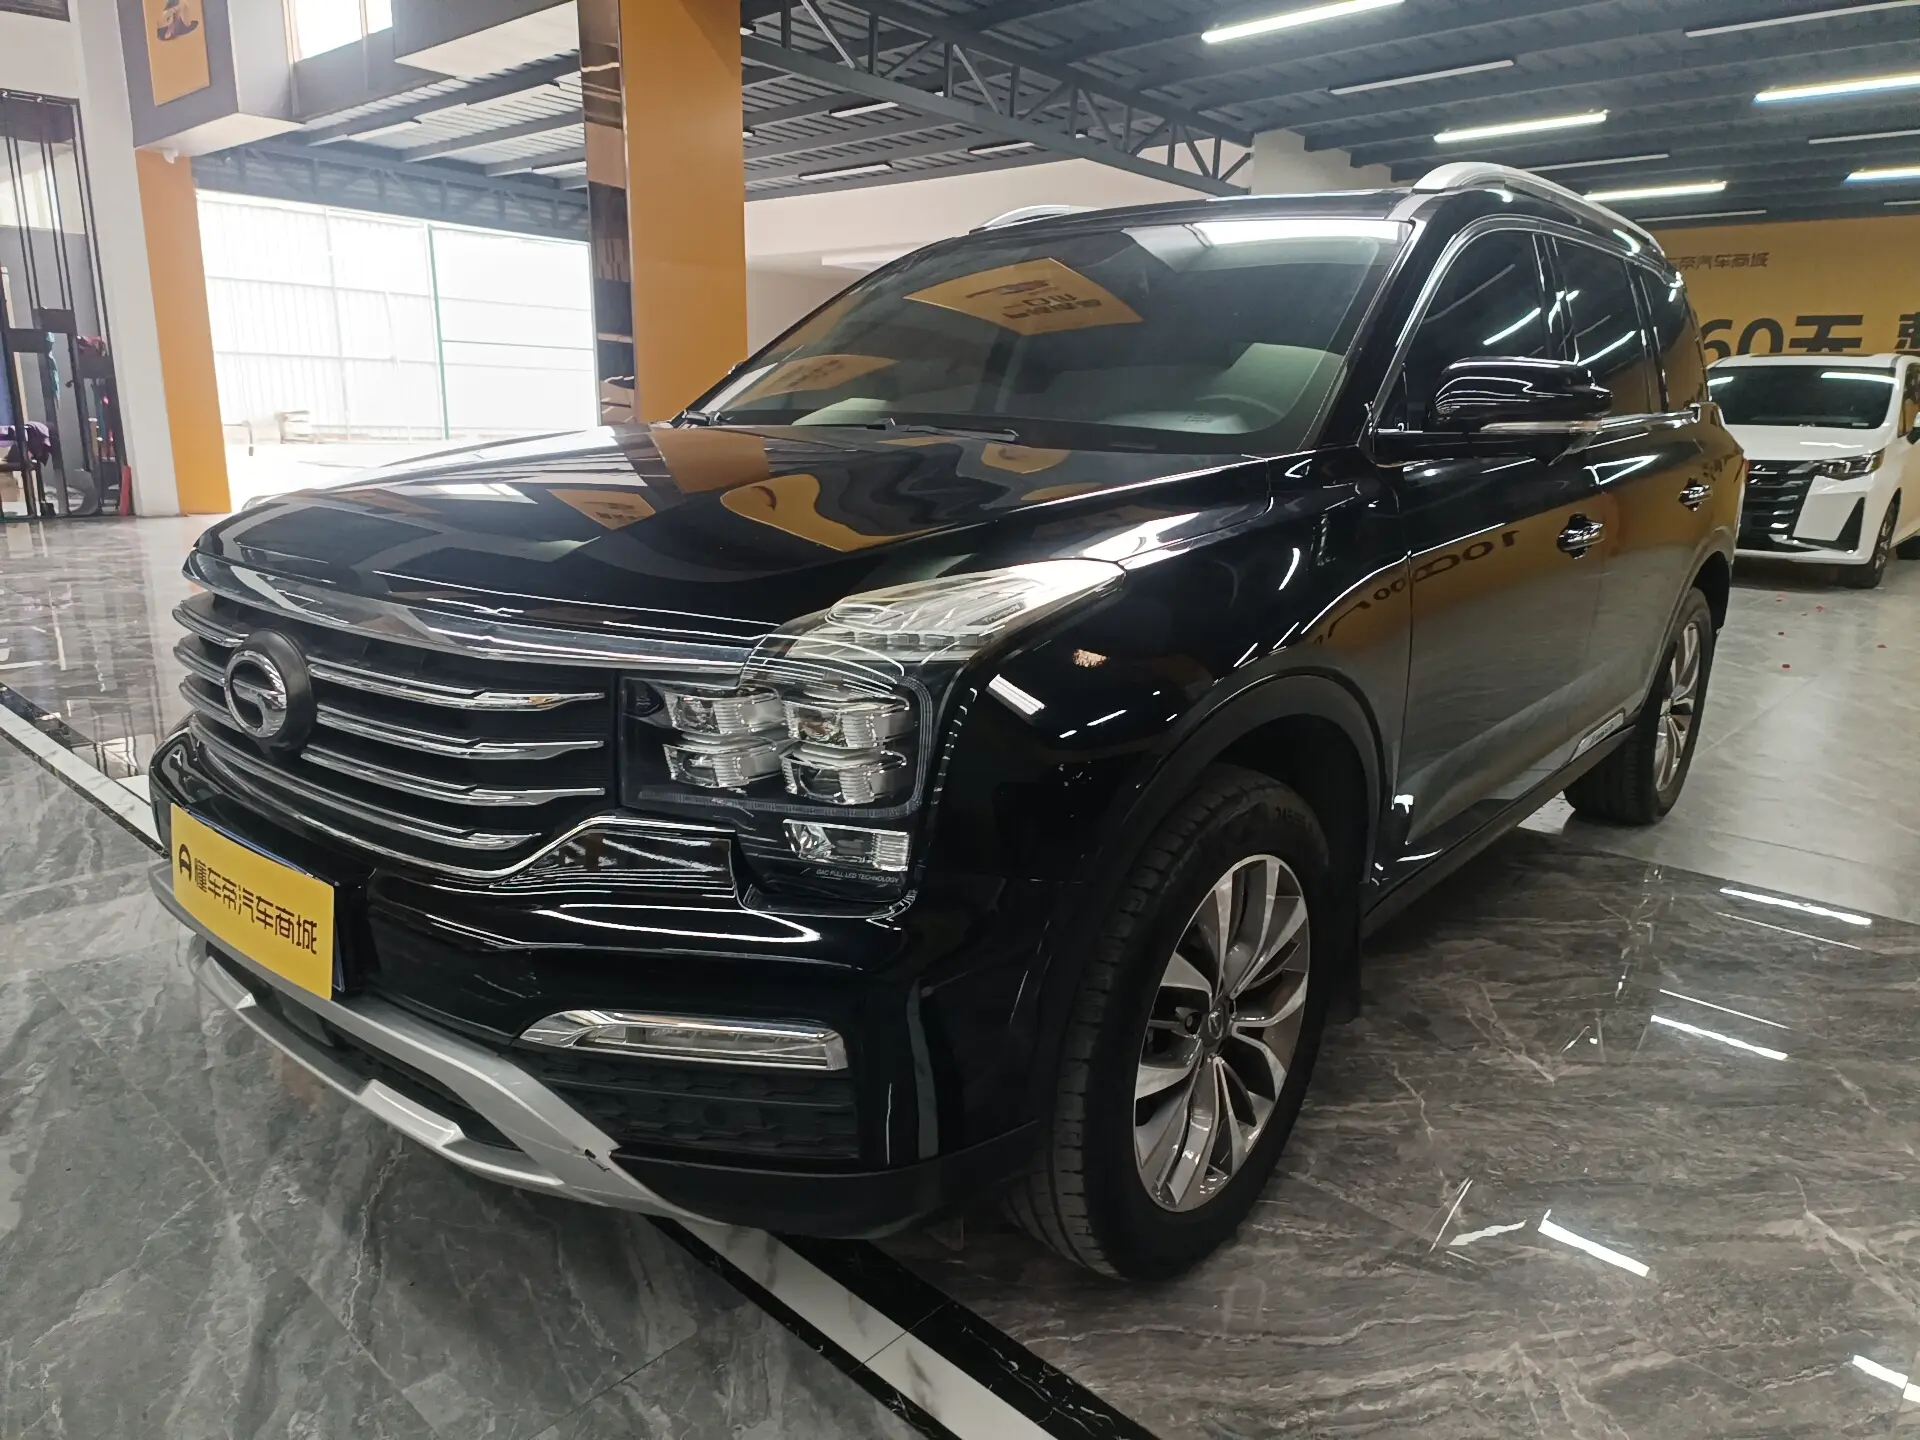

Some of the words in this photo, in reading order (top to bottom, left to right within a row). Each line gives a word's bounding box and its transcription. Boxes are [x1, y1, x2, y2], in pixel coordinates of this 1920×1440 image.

[1668, 252, 1770, 271] 帝汽车商城
[816, 868, 829, 876] GAC
[829, 870, 844, 878] FULL
[858, 873, 900, 884] TECHNOLOGY
[194, 857, 318, 955] 懂车帝汽车商城
